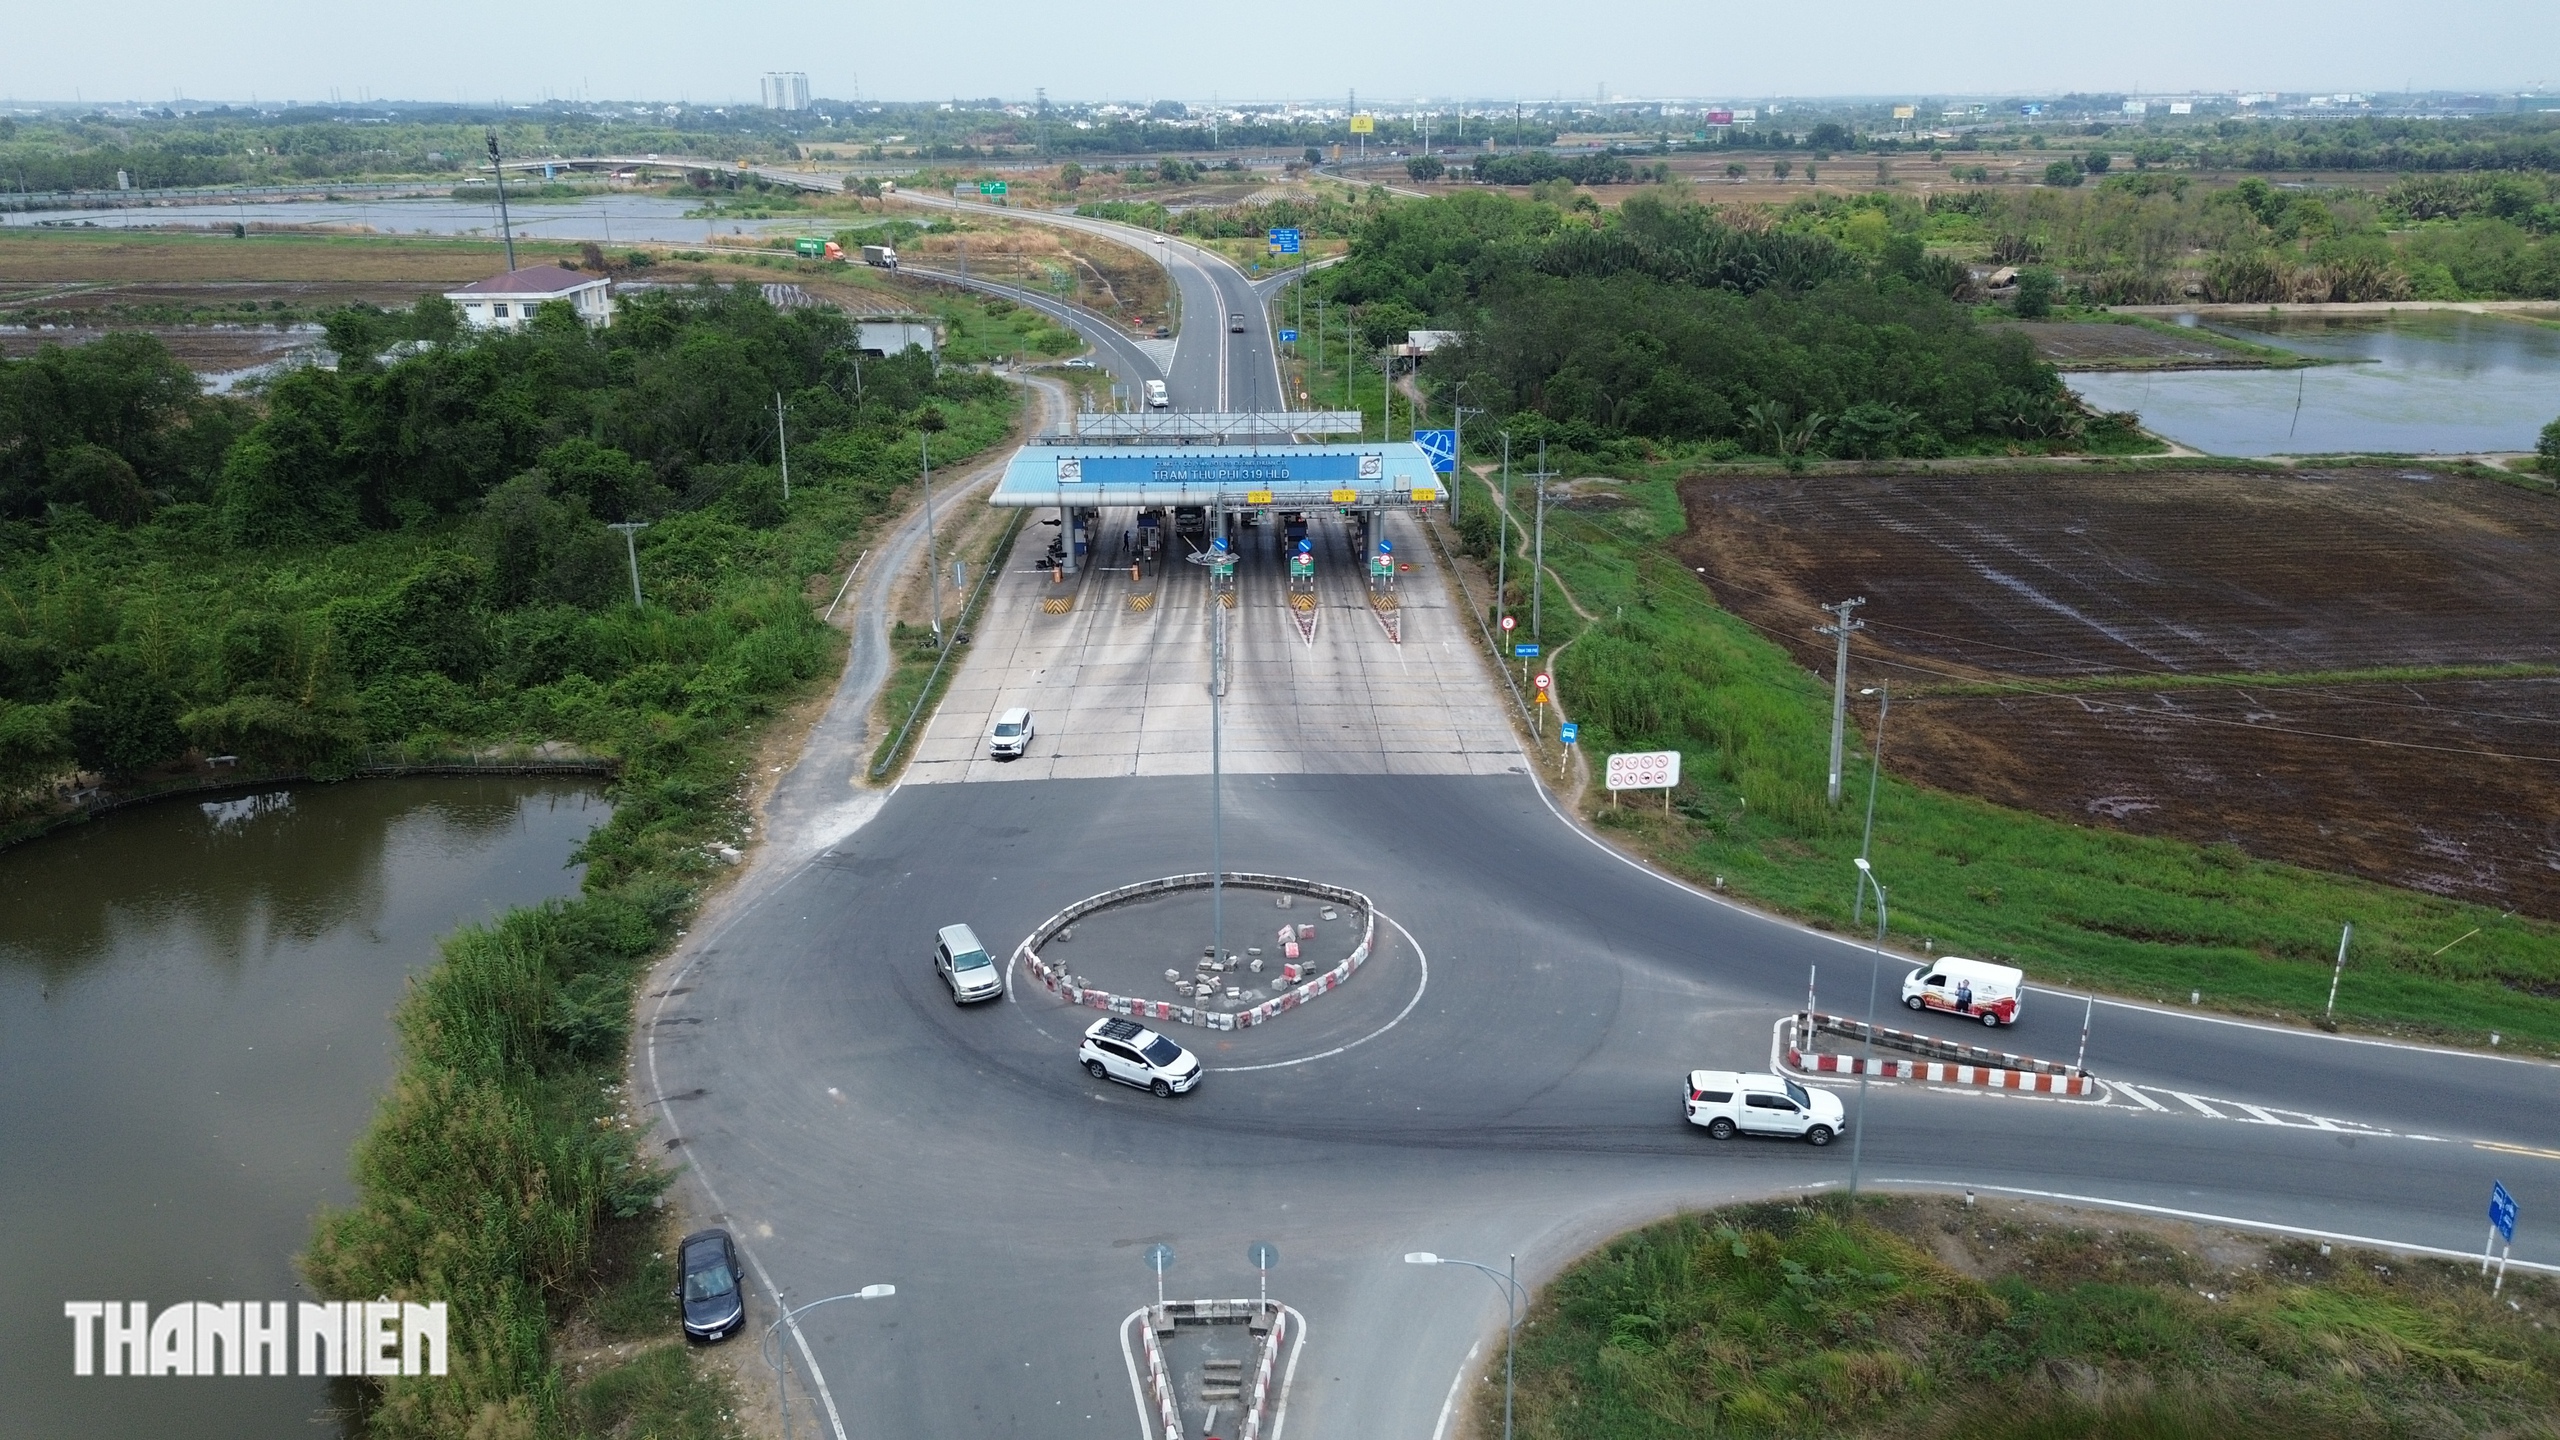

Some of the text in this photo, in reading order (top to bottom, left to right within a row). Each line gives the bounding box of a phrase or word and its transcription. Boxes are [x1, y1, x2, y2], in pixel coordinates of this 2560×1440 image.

[1191, 470, 1216, 480] THU
[1242, 469, 1262, 479] 319
[1266, 469, 1290, 479] HLD
